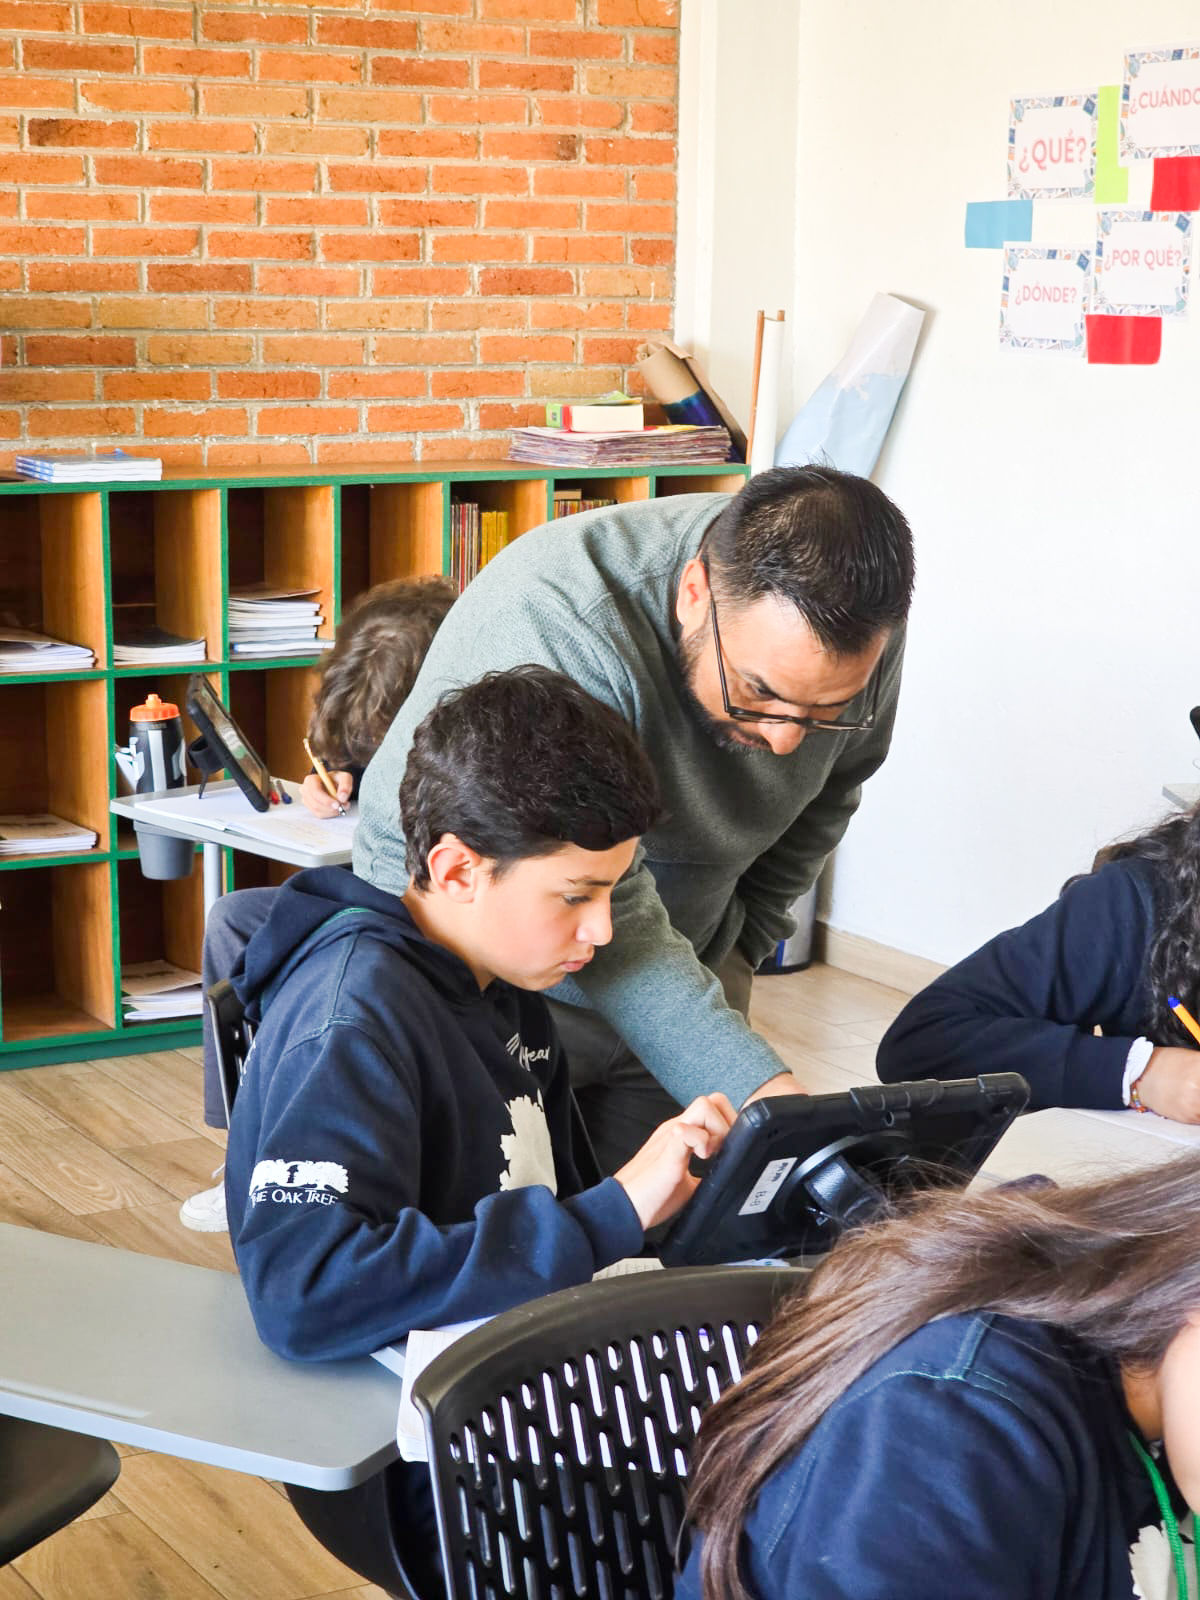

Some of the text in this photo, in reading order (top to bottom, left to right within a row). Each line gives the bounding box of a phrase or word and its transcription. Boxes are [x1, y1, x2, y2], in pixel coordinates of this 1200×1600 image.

[1018, 128, 1087, 173] ¿QUÉ?
[1103, 244, 1182, 271] ¿POR QUÉ?
[1014, 281, 1078, 305] ¿DÓNDE?
[271, 1189, 303, 1204] OAK
